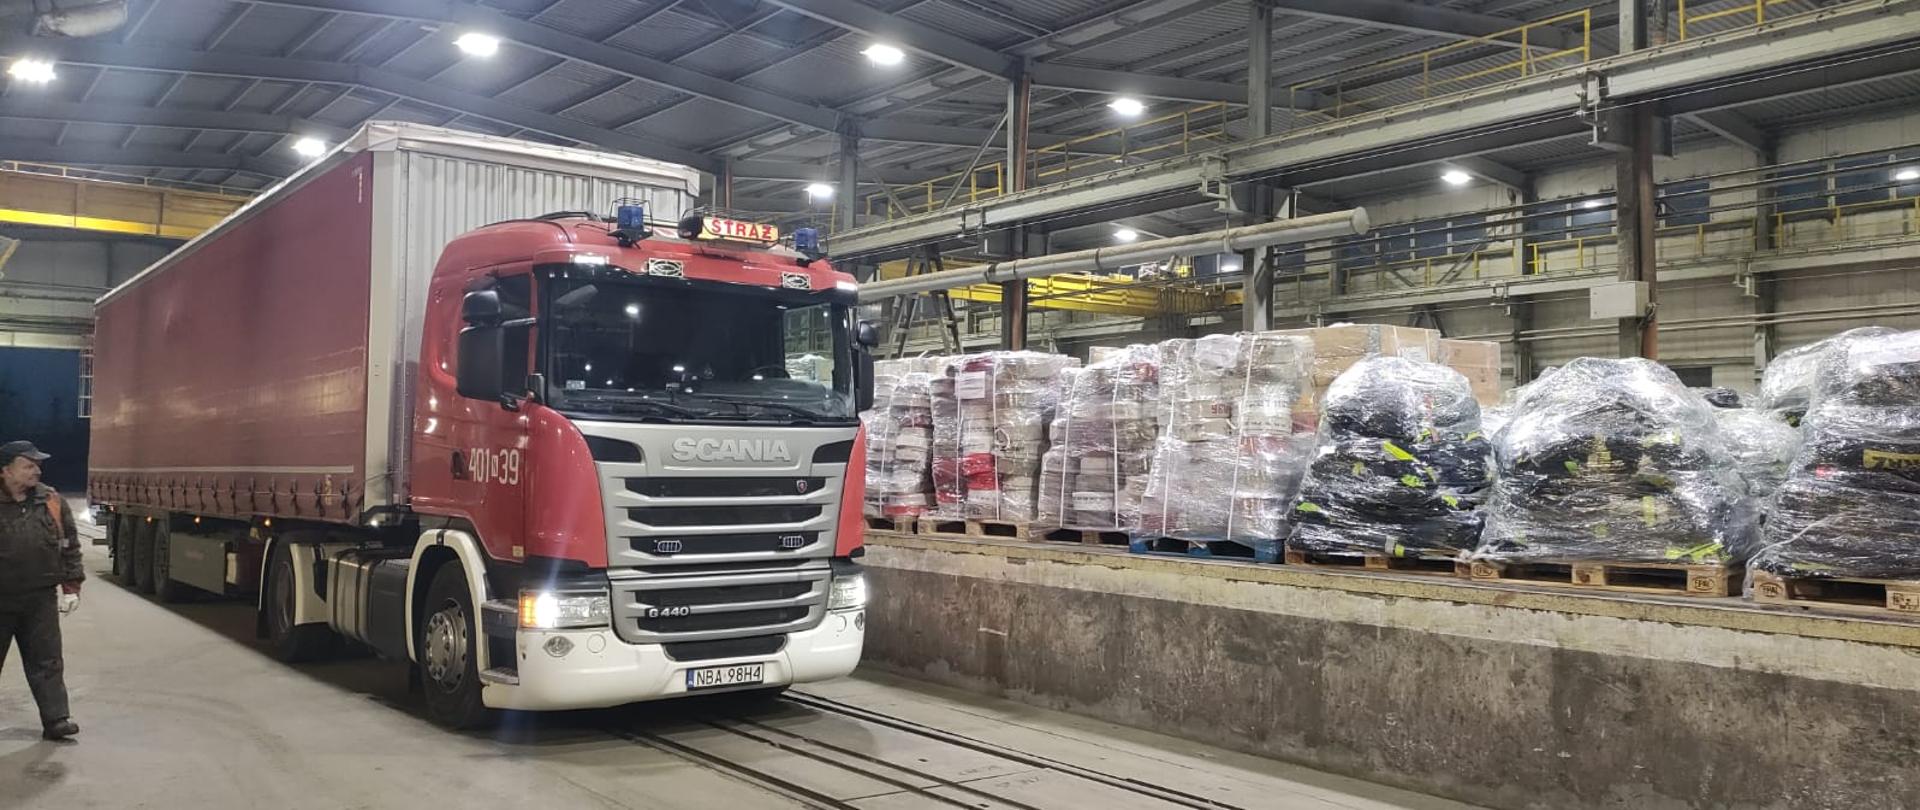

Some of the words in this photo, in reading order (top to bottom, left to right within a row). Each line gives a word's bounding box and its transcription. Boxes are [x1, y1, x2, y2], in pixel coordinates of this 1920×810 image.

[672, 437, 791, 462] SCANIA
[648, 608, 659, 618] G
[660, 606, 689, 617] 440
[696, 669, 722, 686] NBA
[728, 666, 761, 683] 98H4
